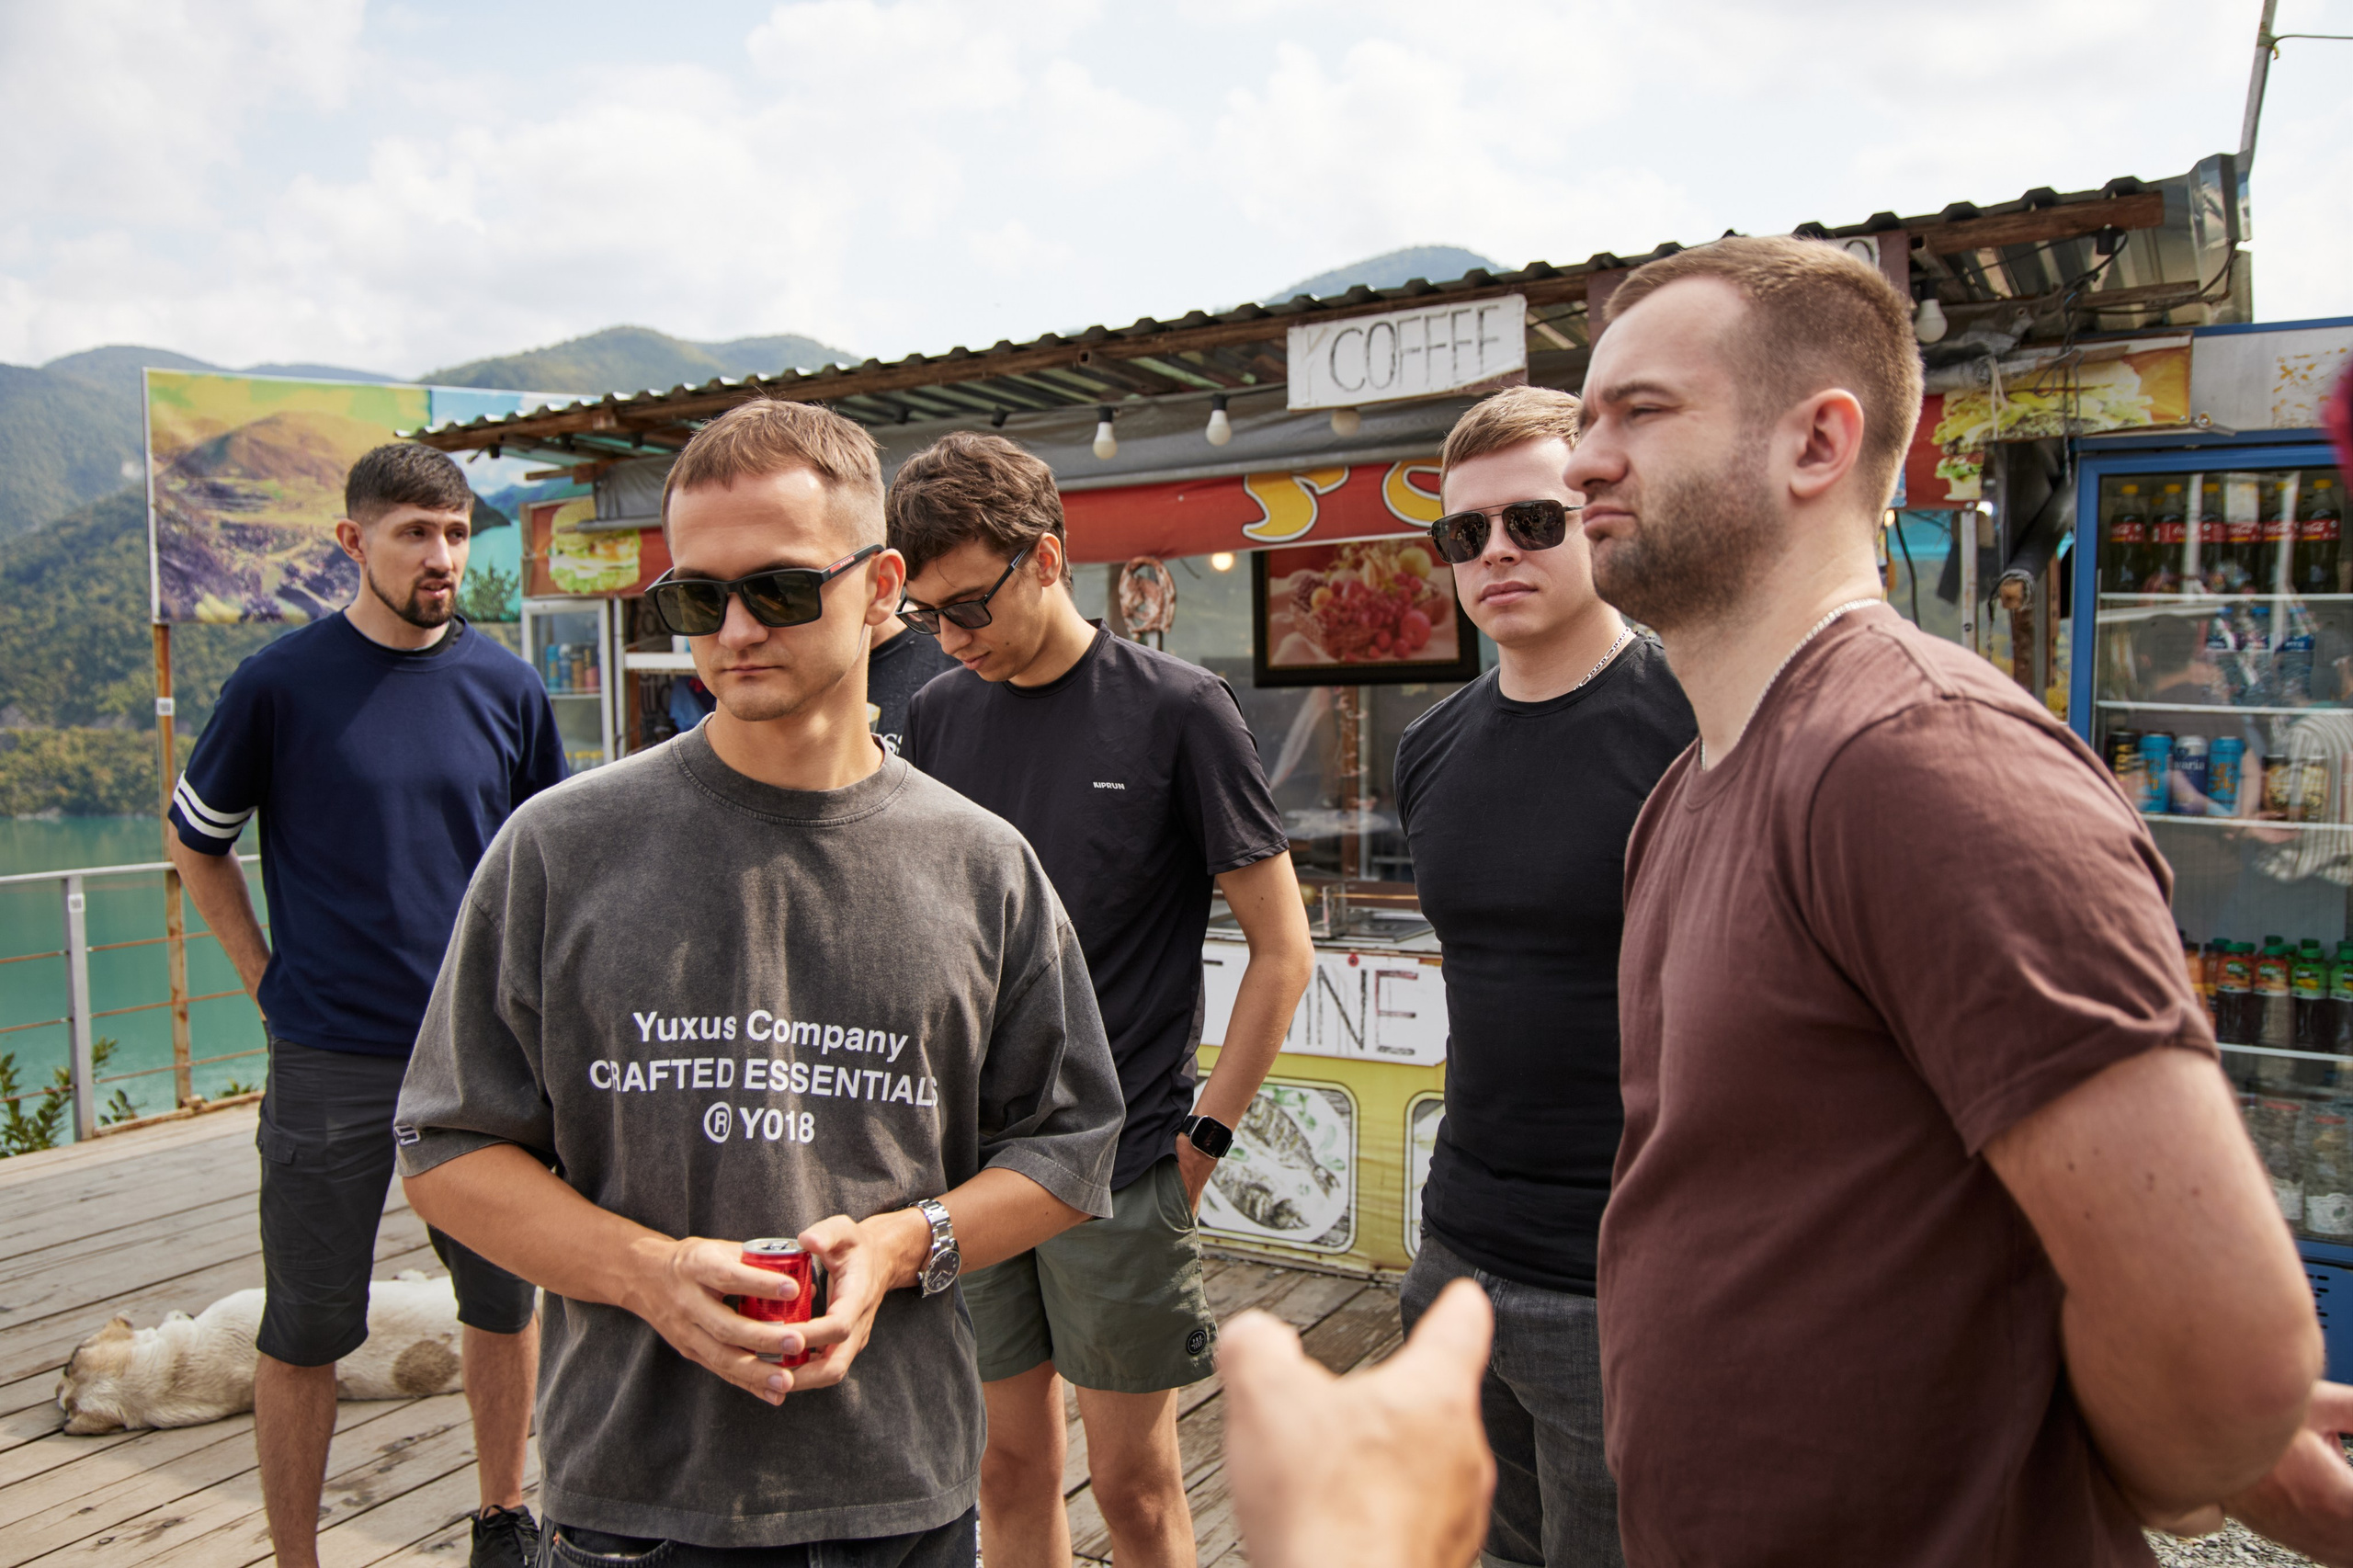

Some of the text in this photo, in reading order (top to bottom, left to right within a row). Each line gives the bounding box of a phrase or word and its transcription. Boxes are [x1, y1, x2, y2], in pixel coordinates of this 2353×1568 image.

[1329, 304, 1499, 392] COFFEE
[1092, 781, 1126, 790] KIPRUN
[633, 1009, 909, 1062] Yuxus Company
[1288, 964, 1419, 1056] INE
[589, 1057, 938, 1107] CRAFTED ESSENTIALS
[740, 1107, 815, 1142] Y018
